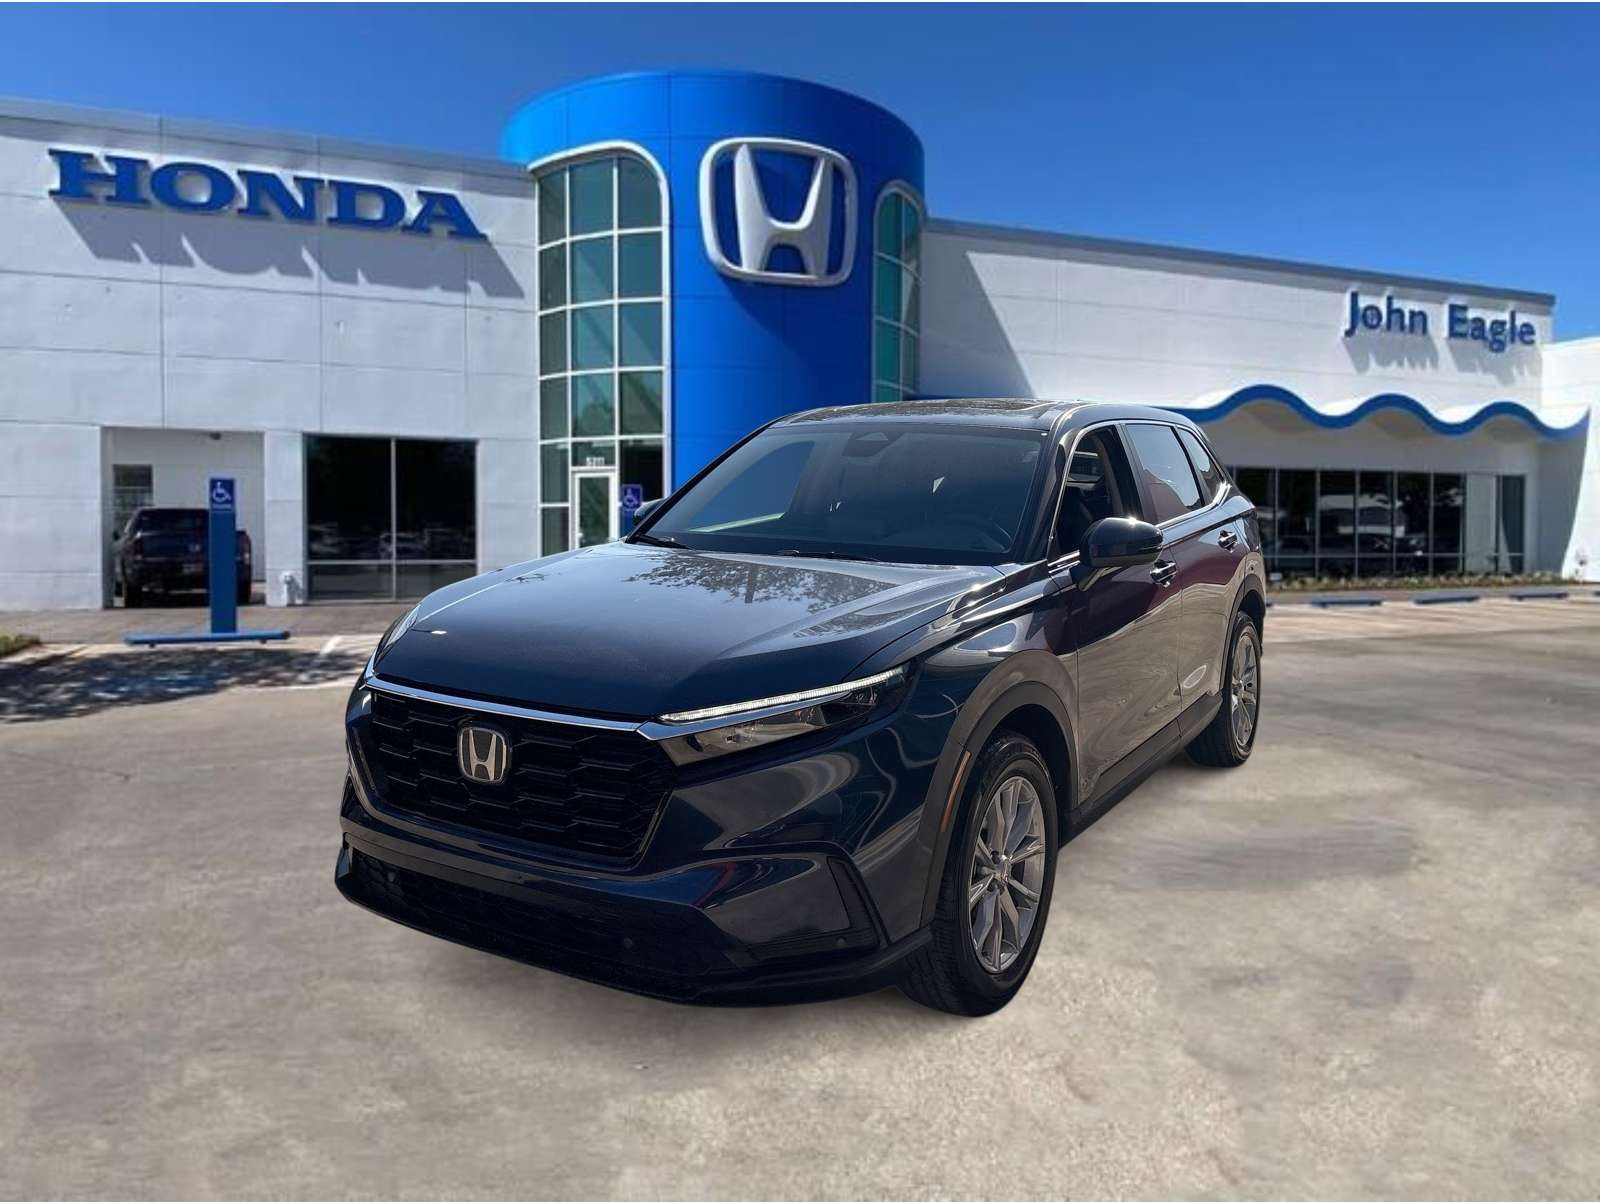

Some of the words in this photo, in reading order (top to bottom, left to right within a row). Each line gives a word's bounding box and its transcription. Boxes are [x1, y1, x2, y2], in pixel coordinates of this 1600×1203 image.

[48, 148, 488, 240] HONDA
[1344, 291, 1428, 337] John
[1448, 303, 1536, 353] Eagle
